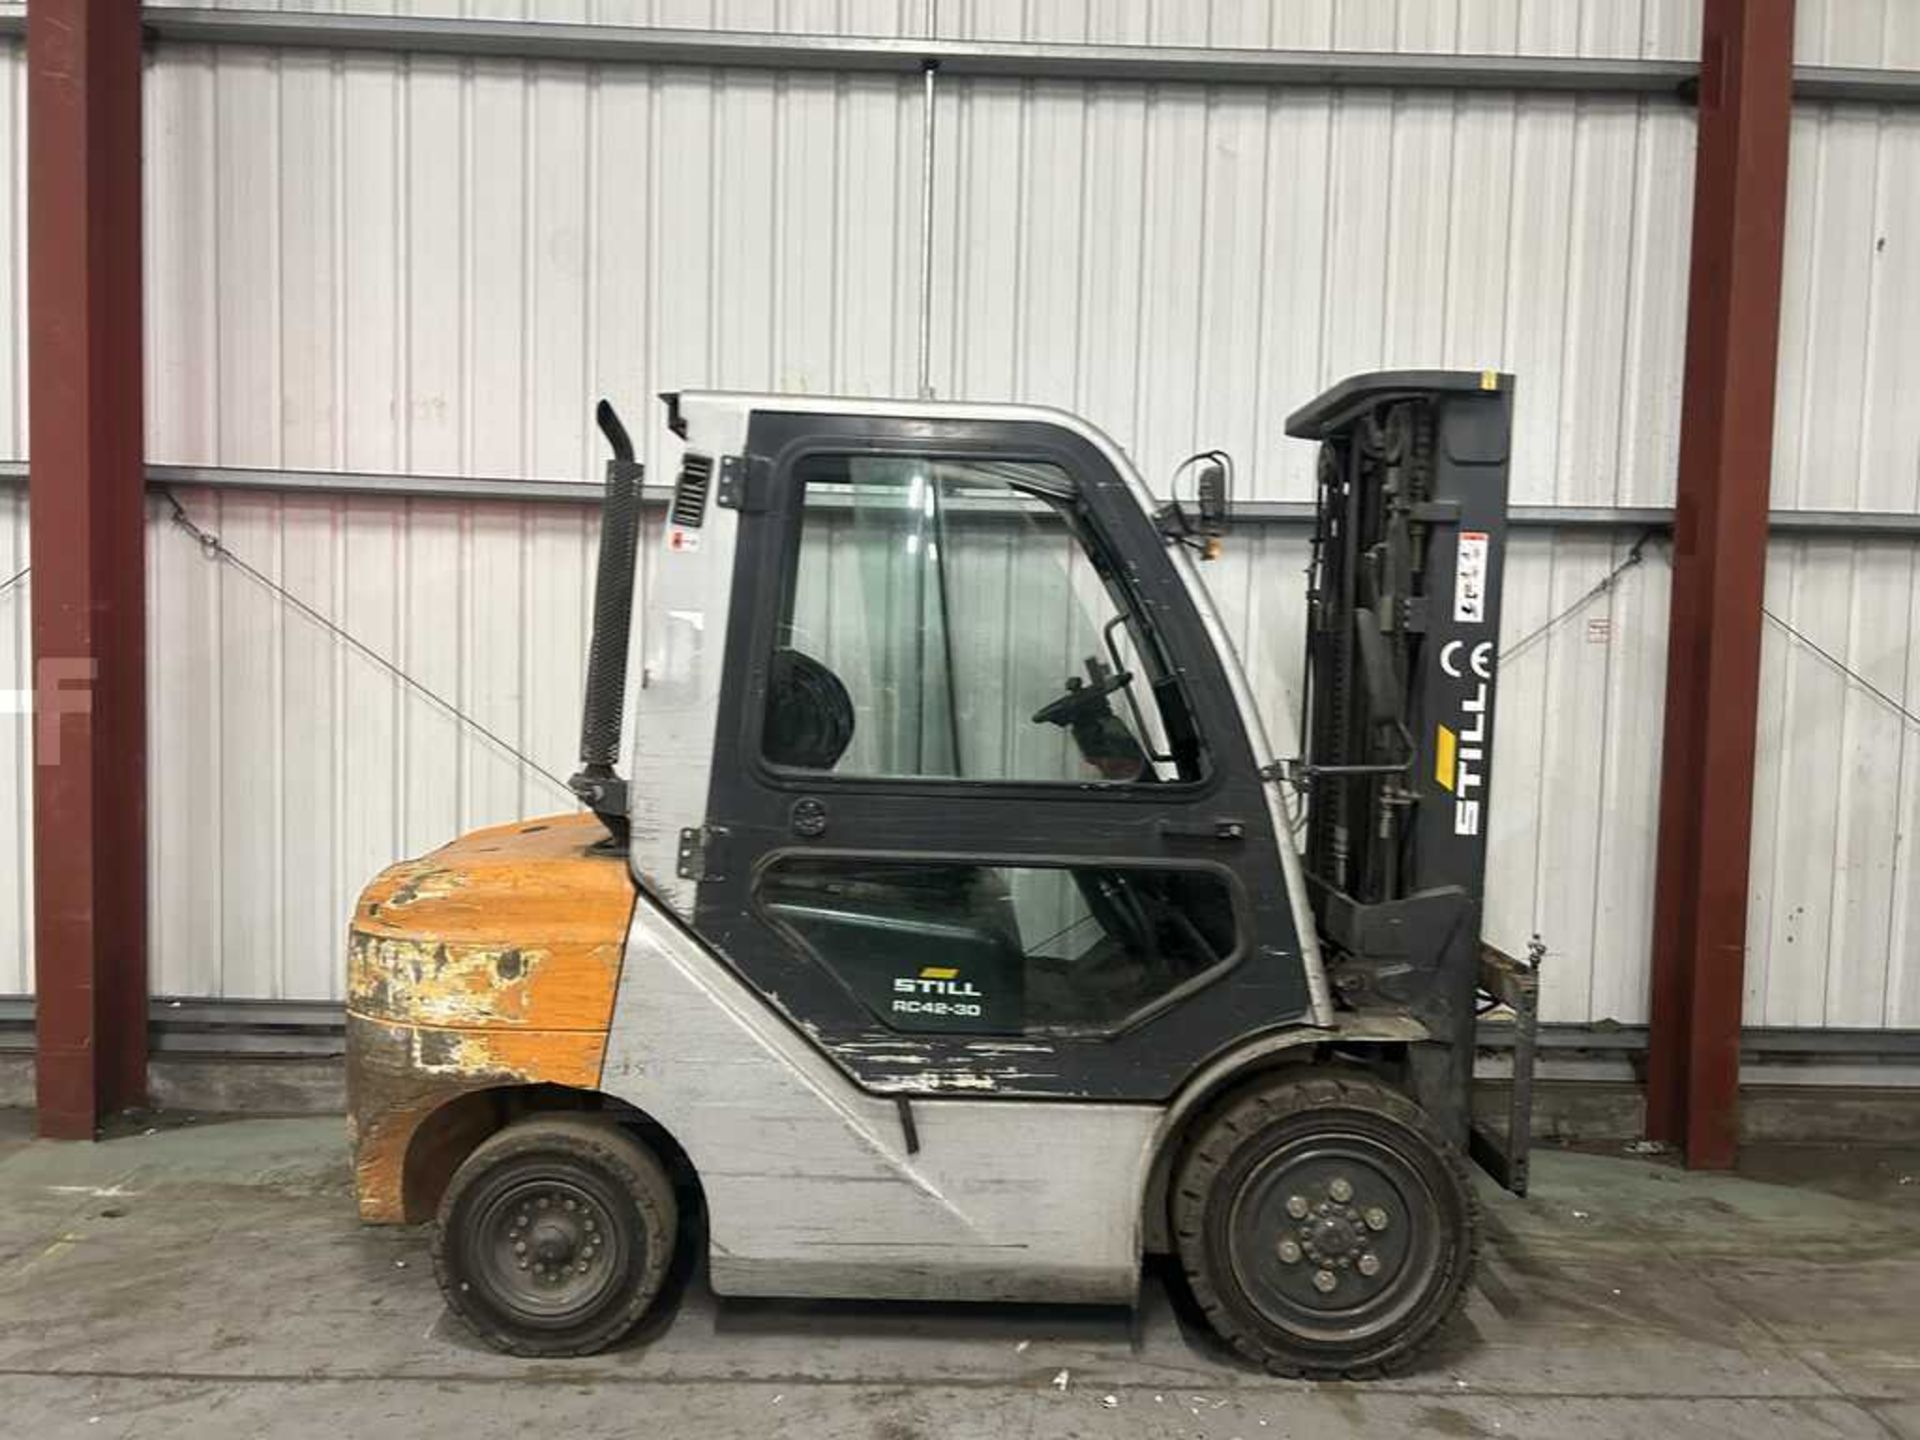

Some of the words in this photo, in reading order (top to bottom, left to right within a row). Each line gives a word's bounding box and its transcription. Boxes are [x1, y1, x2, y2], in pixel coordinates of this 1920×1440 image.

[1454, 683, 1487, 836] STILL
[893, 978, 982, 997] STILL
[892, 1000, 982, 1017] RC42-30
